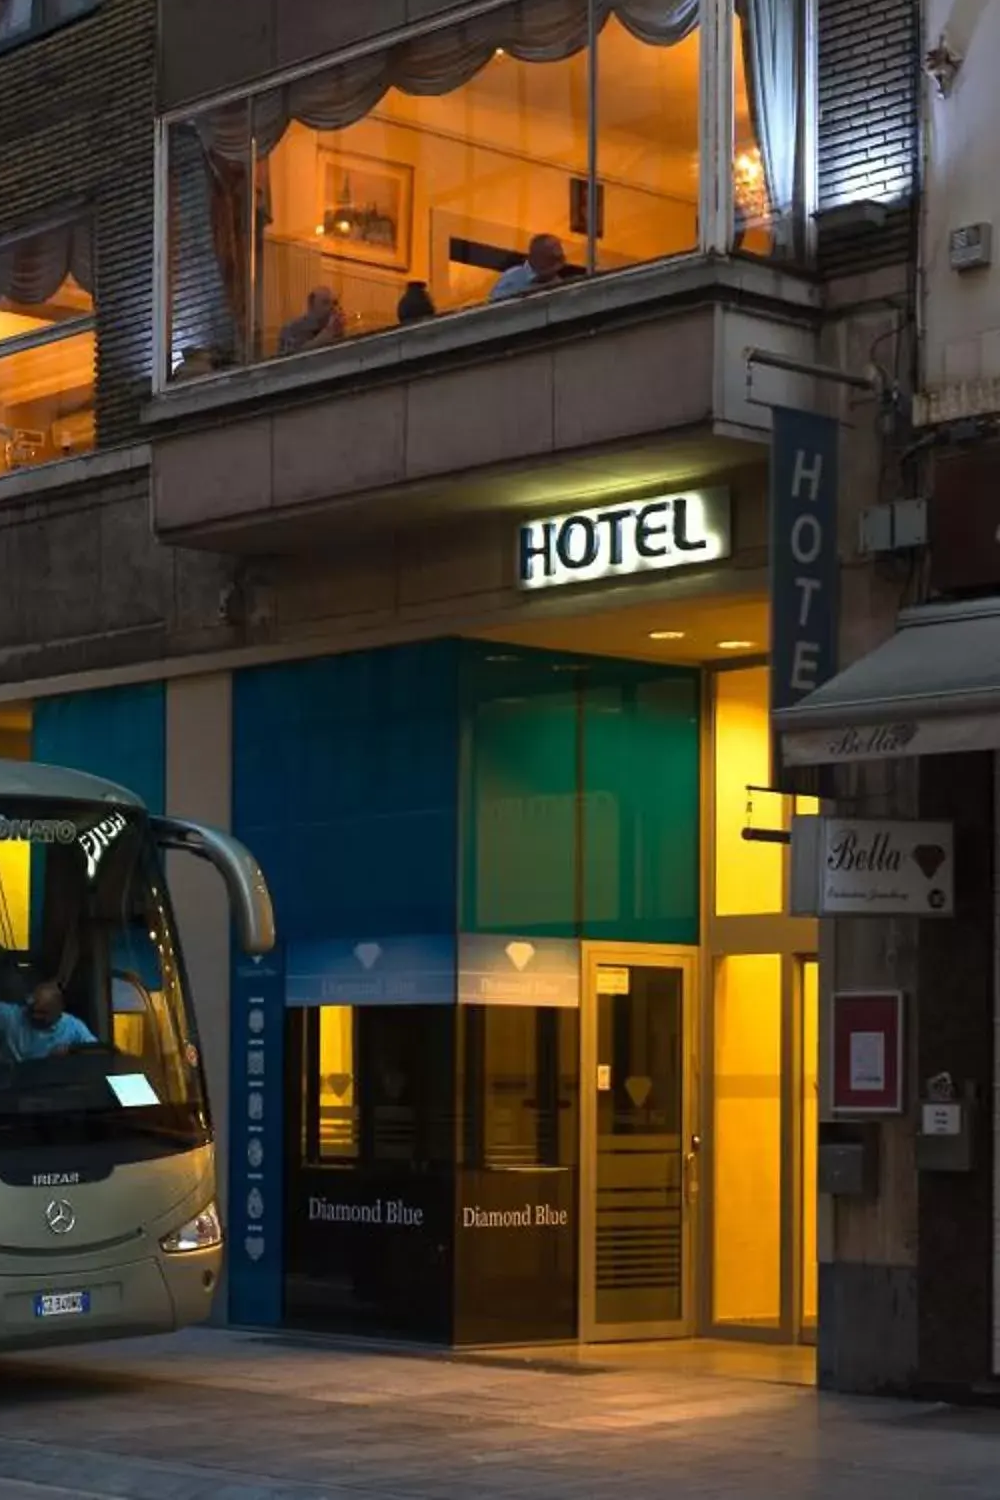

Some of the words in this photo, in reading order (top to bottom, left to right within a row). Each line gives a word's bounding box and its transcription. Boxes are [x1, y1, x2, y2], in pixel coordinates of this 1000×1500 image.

[520, 497, 707, 580] HOTEL
[827, 830, 900, 872] Bella
[309, 1197, 381, 1223] Diamond
[386, 1200, 423, 1226] Blue
[463, 1204, 531, 1228] Diamond
[535, 1204, 567, 1225] Blue
